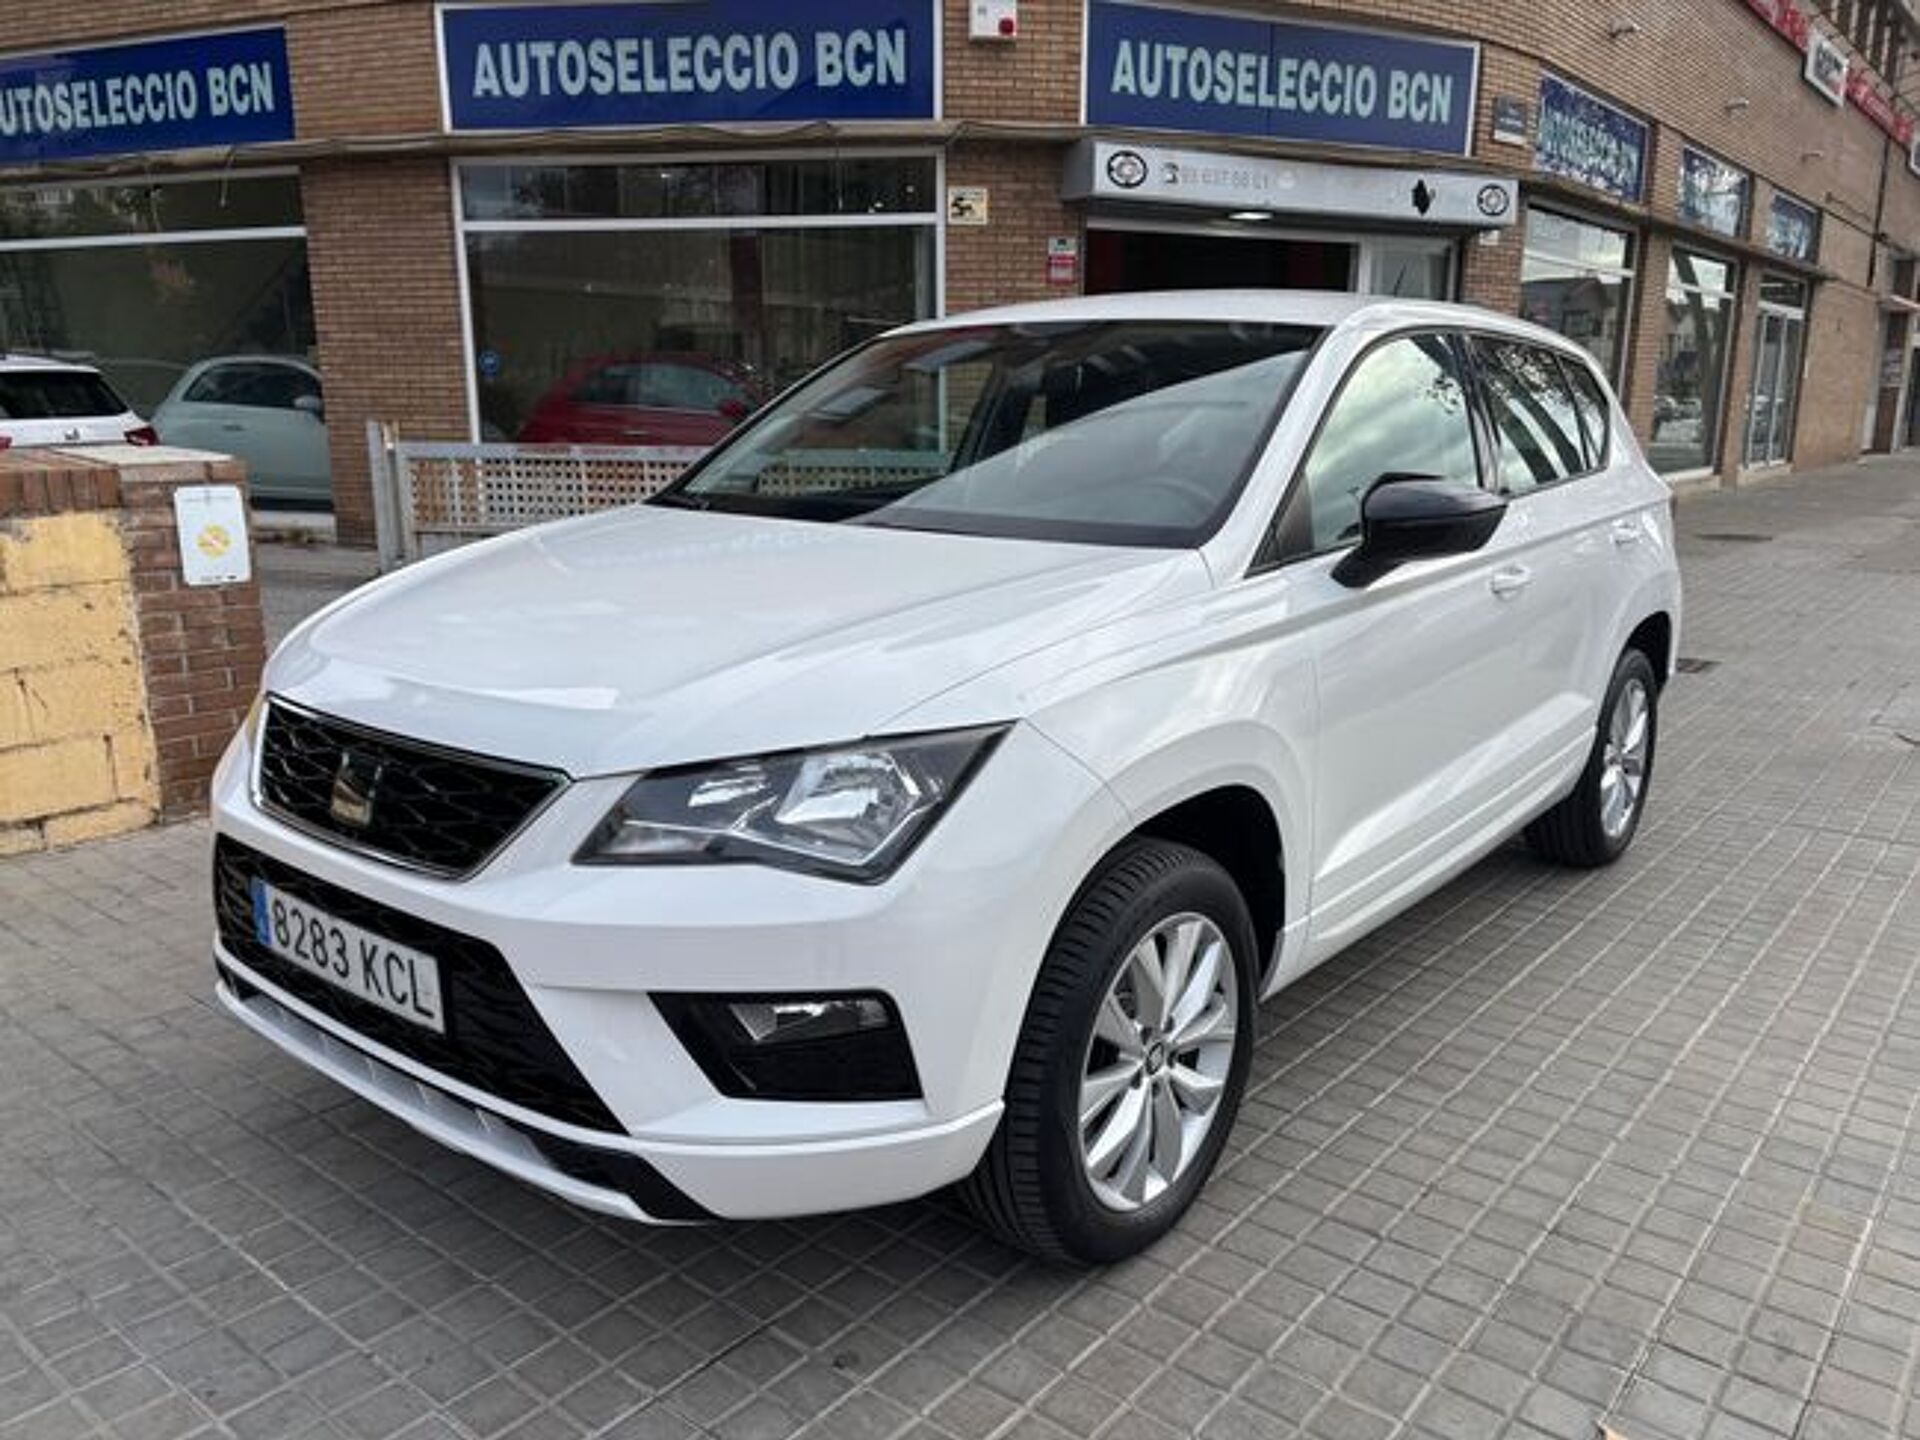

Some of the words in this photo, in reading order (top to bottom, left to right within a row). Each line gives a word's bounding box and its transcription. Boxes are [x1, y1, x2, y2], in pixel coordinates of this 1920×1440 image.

[207, 62, 274, 116] BCN
[473, 32, 798, 98] AUTOSELECCIO
[815, 29, 905, 87] BCN
[1111, 40, 1377, 118] AUTOSELECCIO
[1388, 70, 1452, 124] BCN
[272, 898, 349, 979] 8283
[360, 939, 434, 1020] KCL
